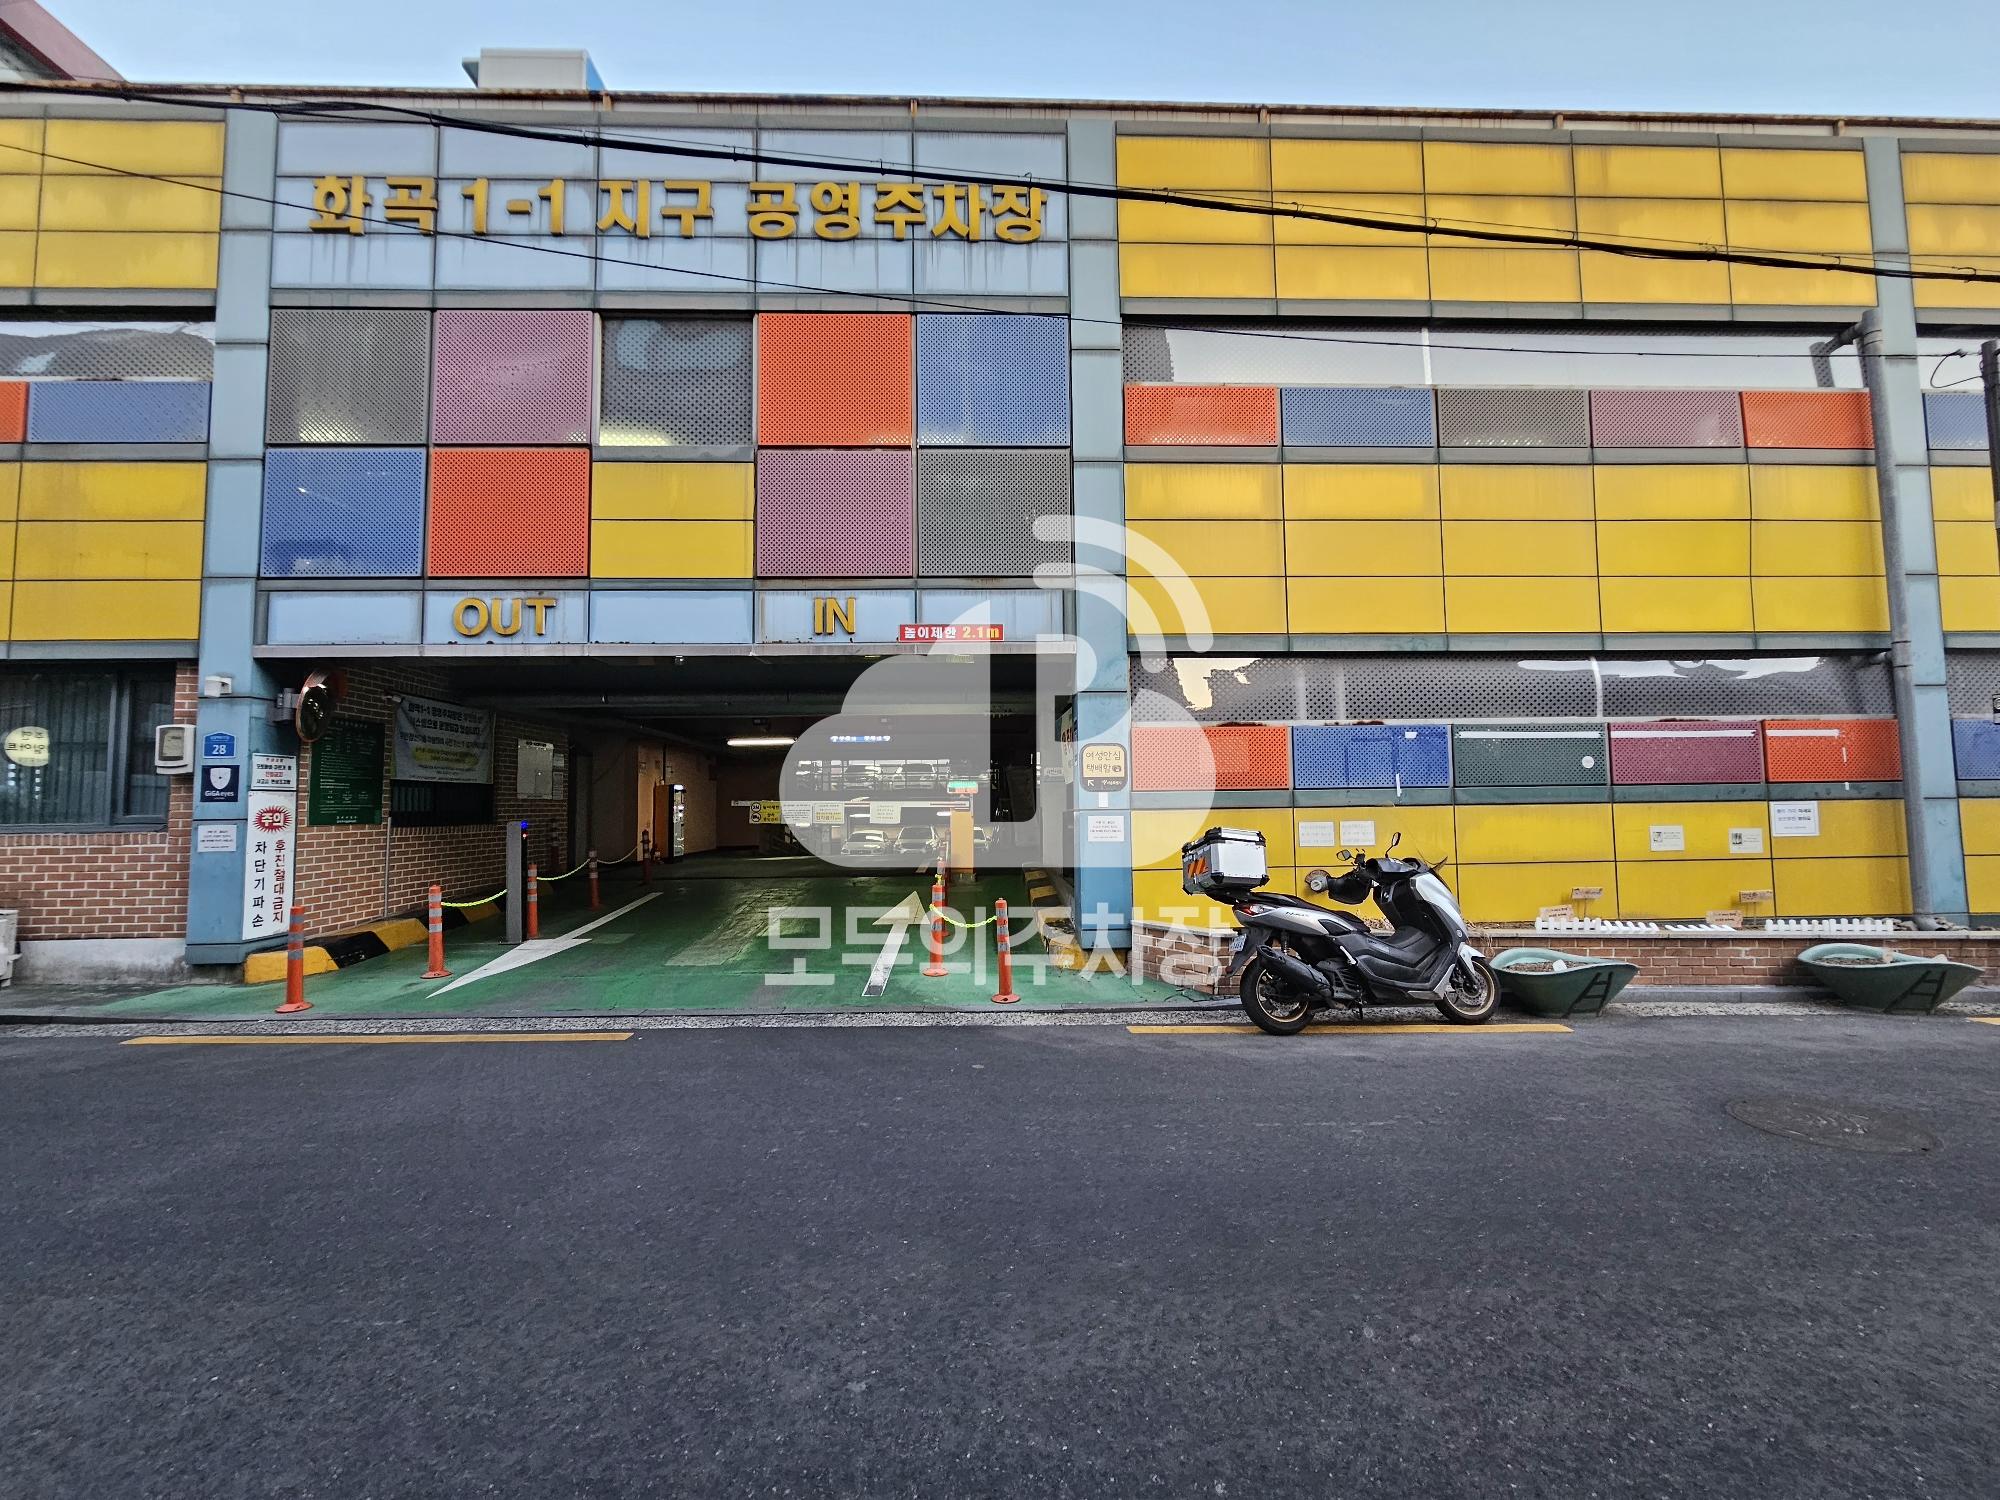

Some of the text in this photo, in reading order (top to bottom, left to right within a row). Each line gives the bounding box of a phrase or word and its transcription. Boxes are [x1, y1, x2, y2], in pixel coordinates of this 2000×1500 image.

[747, 181, 1048, 243] 공영주차장
[453, 598, 556, 636] OUT
[814, 597, 857, 636] IN
[904, 626, 1000, 639] 높이제한 2.1m
[212, 744, 227, 755] 28
[1085, 751, 1121, 761] 여성안심
[1086, 763, 1111, 773] 택배함
[261, 812, 284, 827] 주의
[252, 841, 267, 928] 차단기파손
